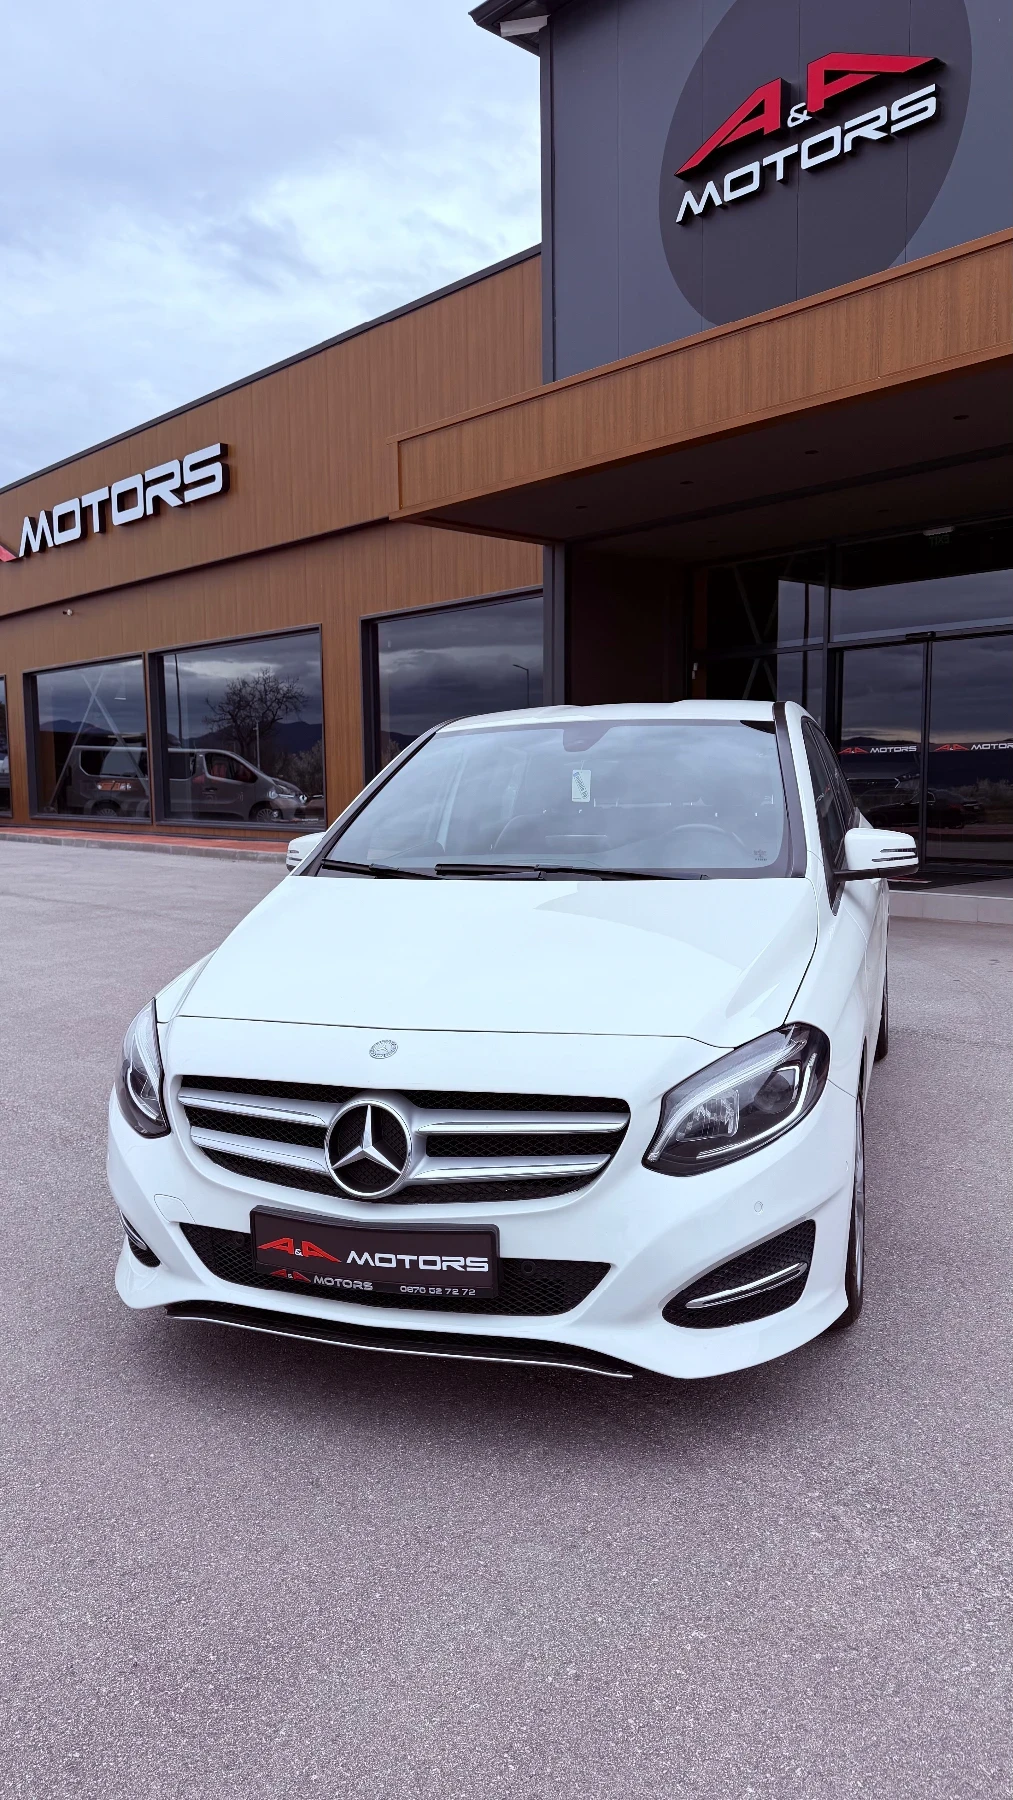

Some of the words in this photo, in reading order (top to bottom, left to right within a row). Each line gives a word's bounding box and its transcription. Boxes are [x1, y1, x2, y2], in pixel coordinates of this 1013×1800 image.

[675, 83, 937, 223] MOTORS
[19, 442, 223, 558] MOTORS
[870, 745, 917, 754] MOTORS
[257, 1237, 342, 1263] A&A
[346, 1250, 489, 1272] MOTORS
[313, 1275, 374, 1291] MOTORS
[444, 1288, 460, 1296] 72
[461, 1288, 476, 1296] 72
